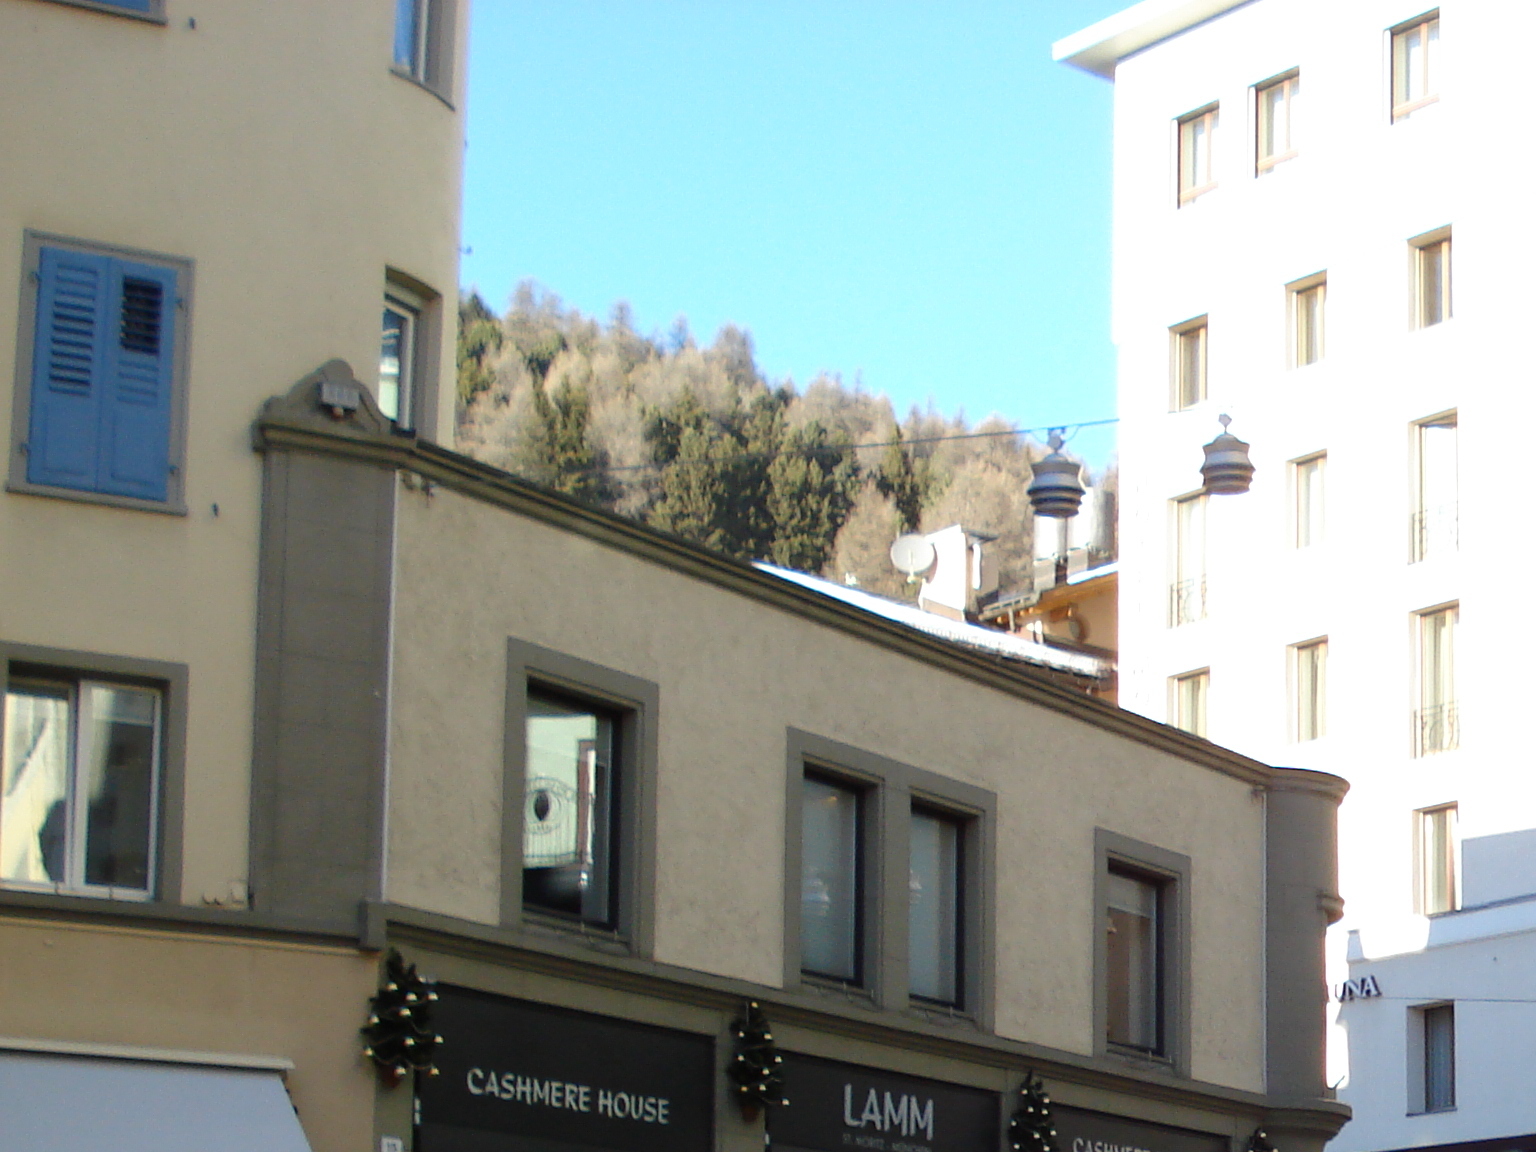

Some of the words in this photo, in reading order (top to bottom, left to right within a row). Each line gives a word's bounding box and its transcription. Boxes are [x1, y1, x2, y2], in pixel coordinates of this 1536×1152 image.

[466, 1067, 591, 1112] CASHMERE
[598, 1089, 670, 1125] HOUSE
[844, 1083, 934, 1141] LAMM
